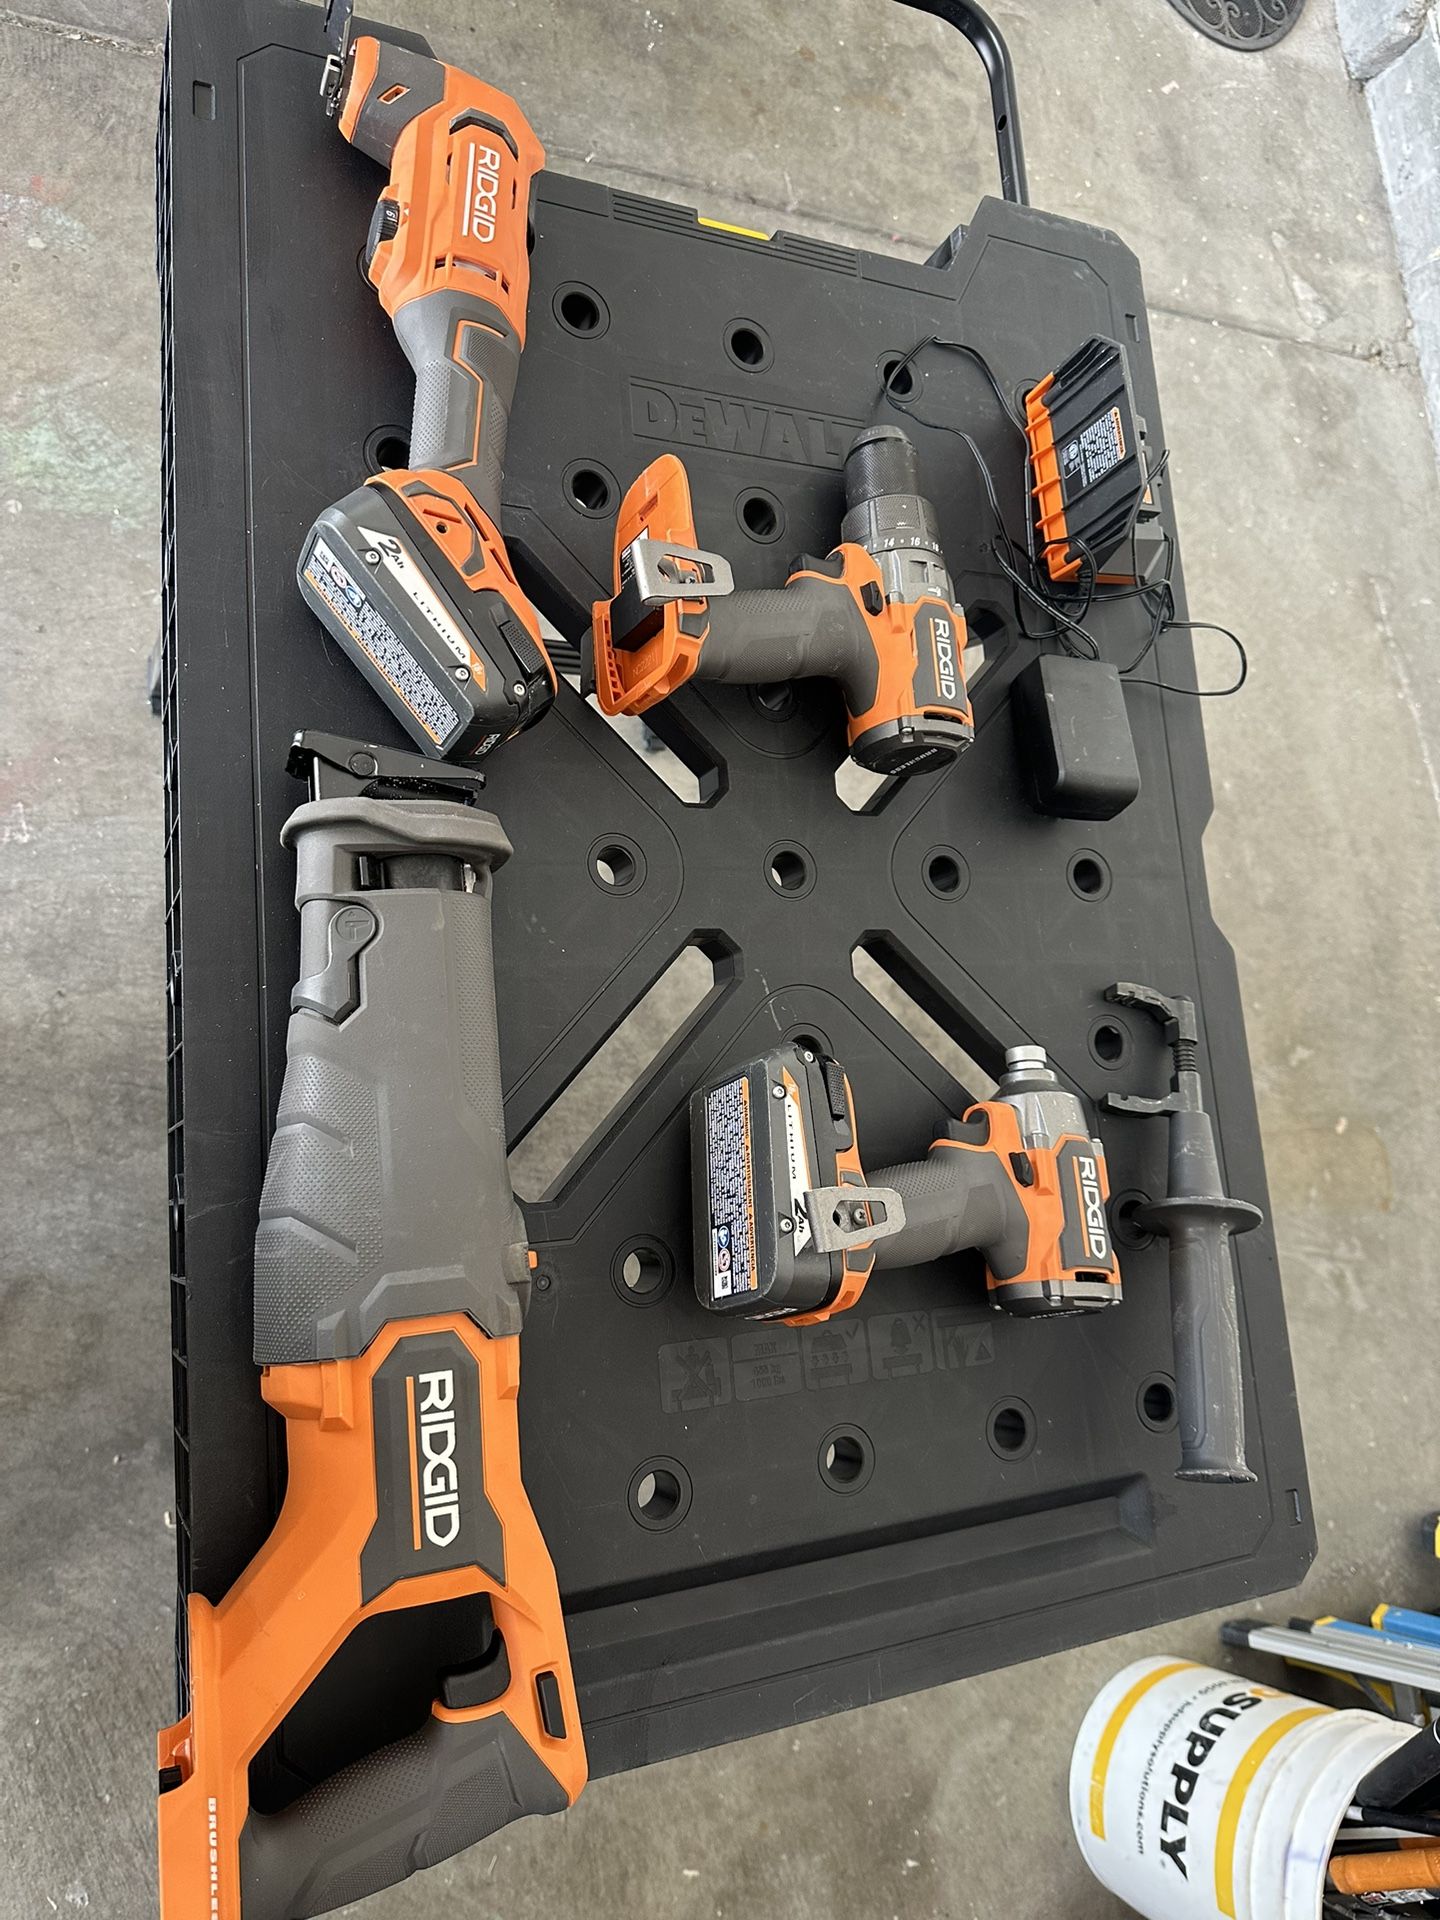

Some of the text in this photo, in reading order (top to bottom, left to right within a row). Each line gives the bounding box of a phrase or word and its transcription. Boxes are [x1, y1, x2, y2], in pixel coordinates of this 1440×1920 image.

[472, 145, 501, 243] RIDGID
[884, 538, 895, 548] 14
[911, 537, 921, 546] 16
[413, 591, 467, 659] LITHIUM
[934, 617, 957, 700] RIDGID
[787, 1103, 798, 1181] LITHIUM
[748, 1221, 756, 1272] ADVERTENCIA
[1079, 1156, 1108, 1259] RIDGID
[418, 1369, 460, 1547] RIDGID
[1161, 1690, 1263, 1881] SUPPLY
